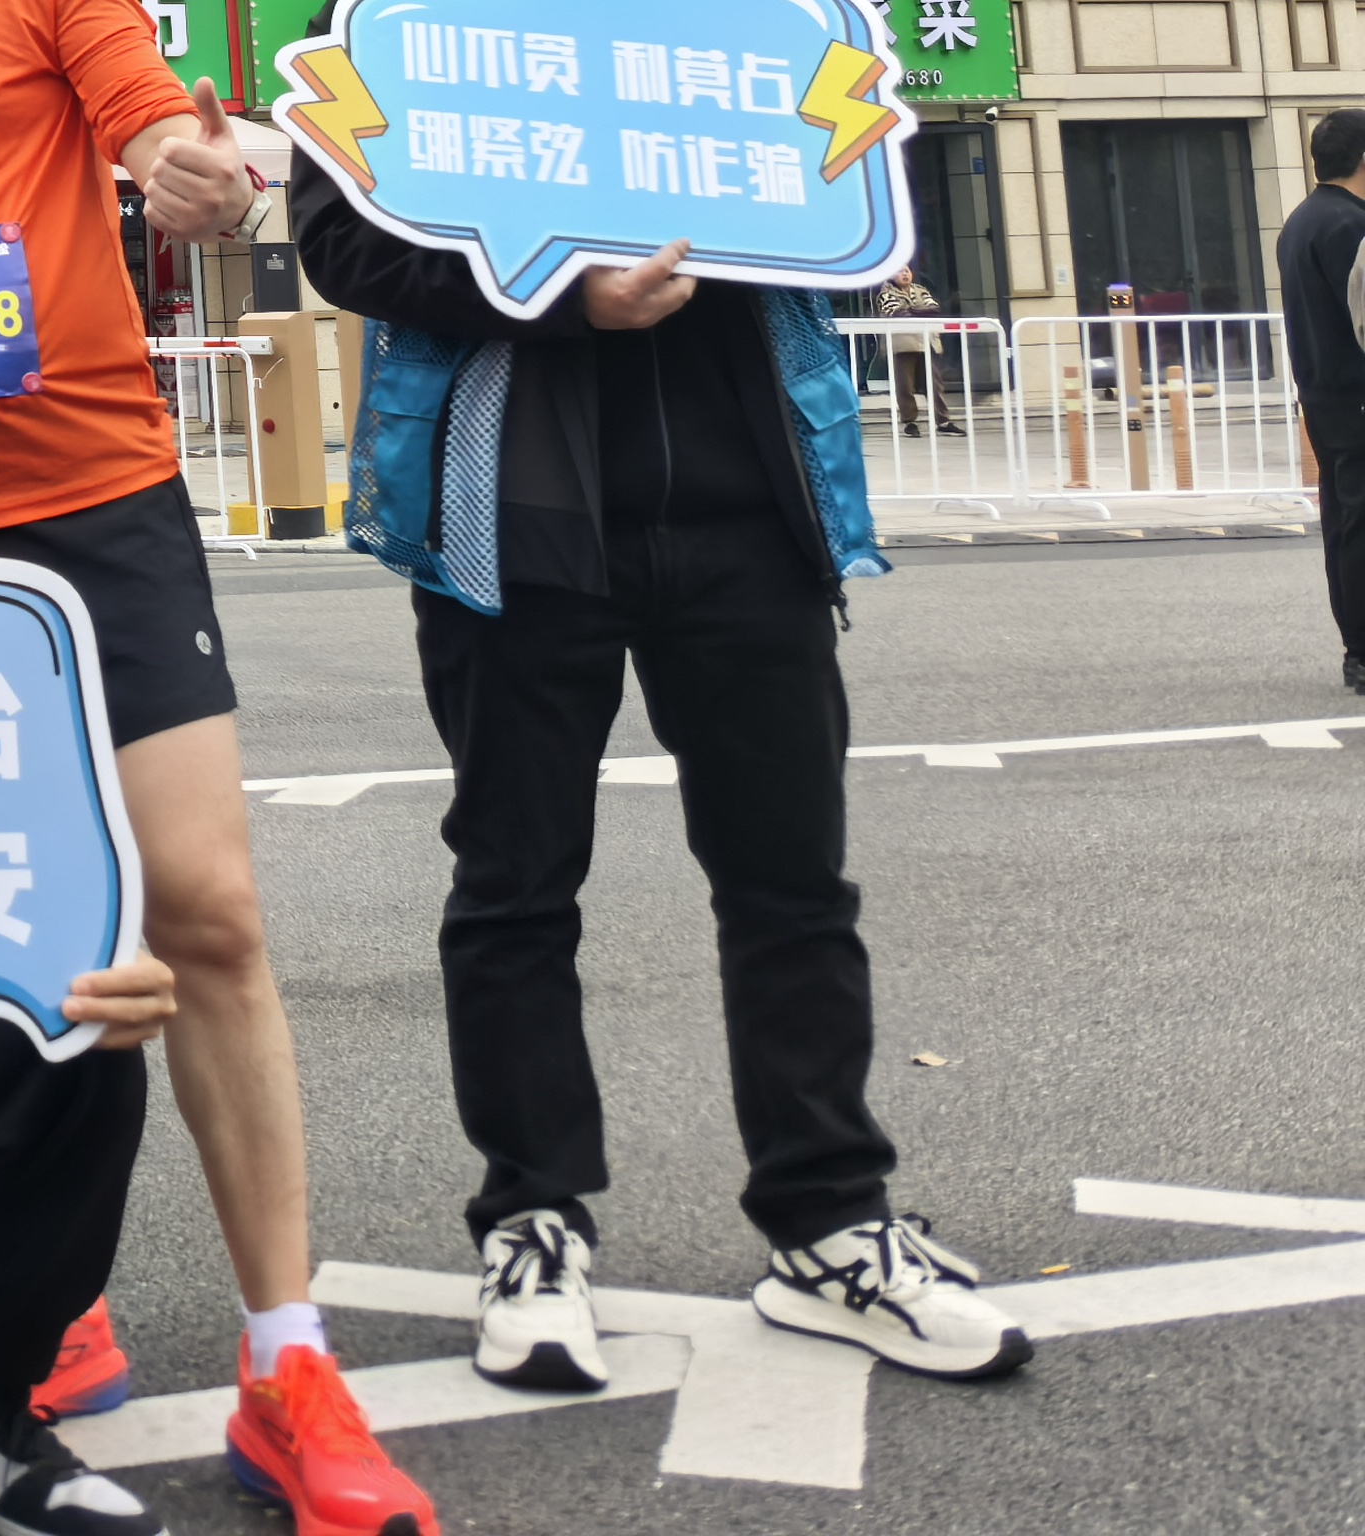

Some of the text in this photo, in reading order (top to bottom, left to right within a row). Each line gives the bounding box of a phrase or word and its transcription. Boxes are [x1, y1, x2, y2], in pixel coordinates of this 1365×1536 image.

[402, 21, 796, 116] 心不贪 利莫占
[898, 69, 943, 86] 680
[407, 109, 807, 206] 绷紧弦 防诈骗
